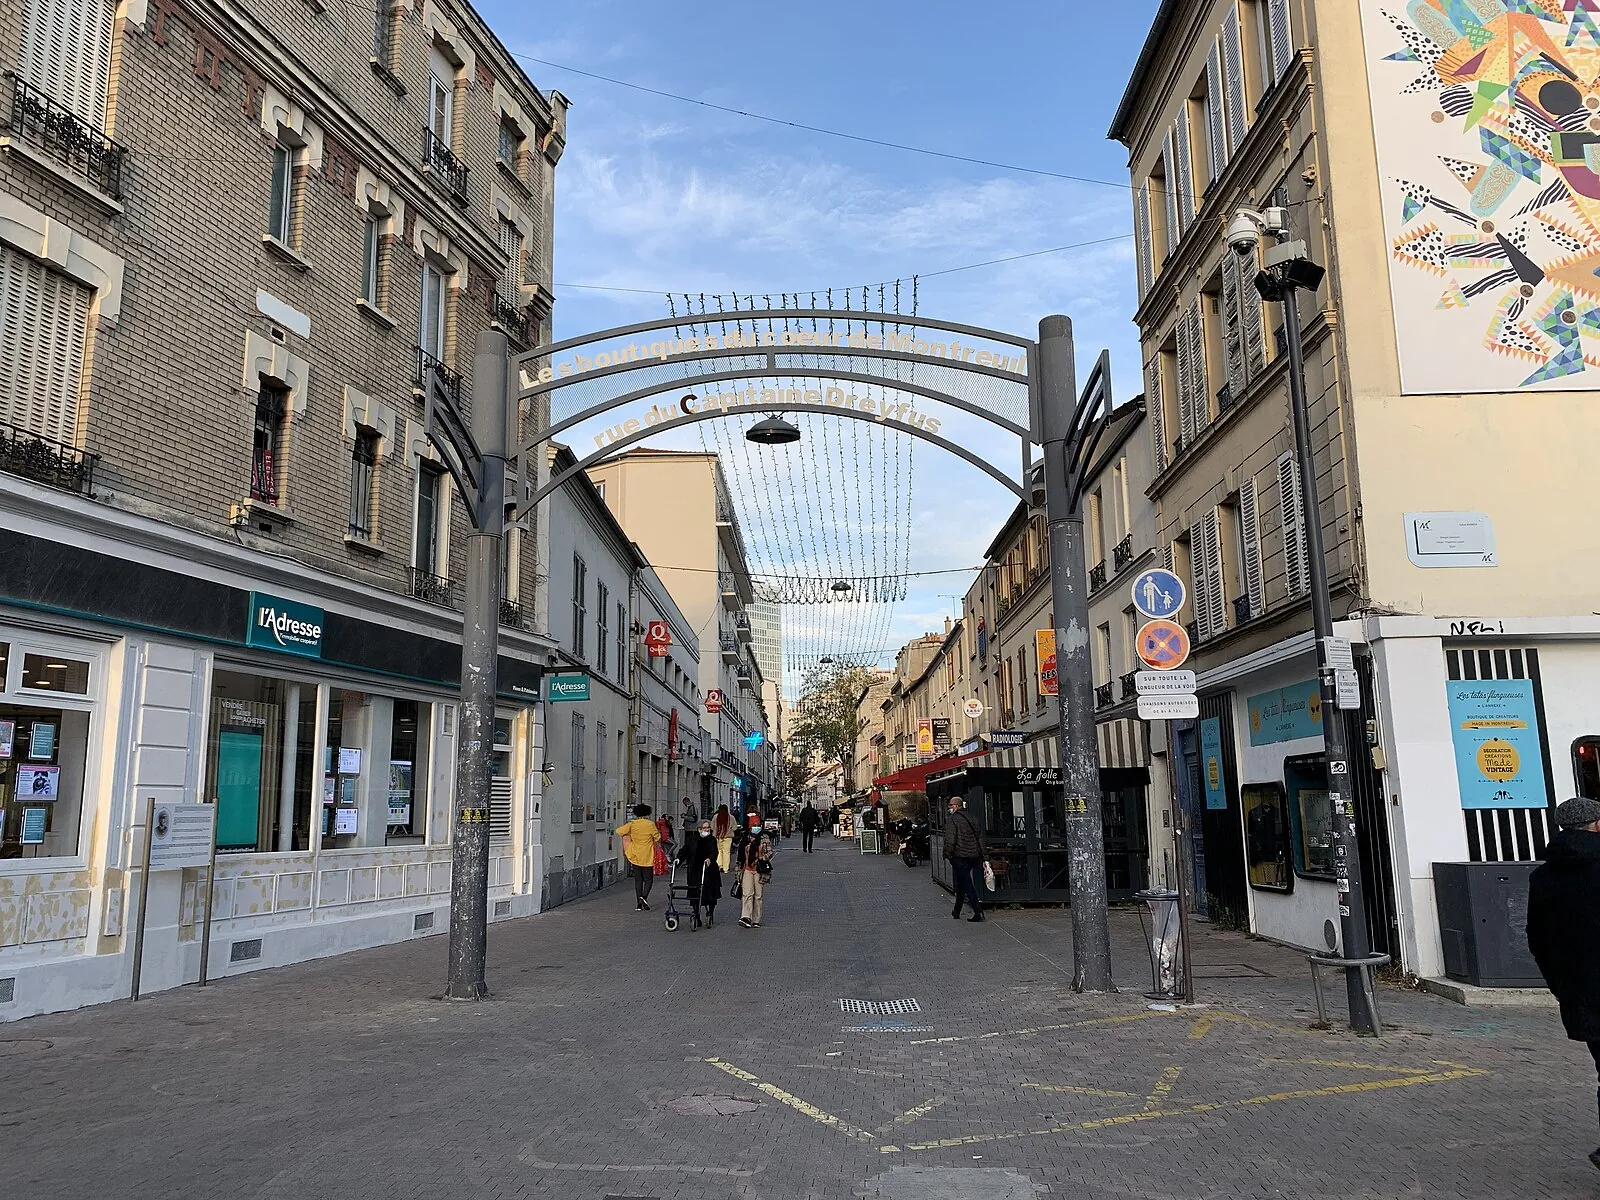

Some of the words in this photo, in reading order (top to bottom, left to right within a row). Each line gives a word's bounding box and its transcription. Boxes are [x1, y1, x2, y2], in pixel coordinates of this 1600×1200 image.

[519, 361, 573, 390] Les
[575, 333, 718, 373] boutiques
[723, 329, 757, 348] du
[848, 329, 882, 349] de
[886, 331, 1027, 375] Montreuil
[593, 417, 641, 449] rue
[644, 404, 678, 427] du
[680, 385, 820, 415] Capitaine
[825, 386, 942, 434] Dreyfus
[1456, 691, 1469, 701] Les
[992, 733, 1023, 744] RADIOLOGIE
[1485, 758, 1512, 766] Mode
[1017, 768, 1032, 780] La
